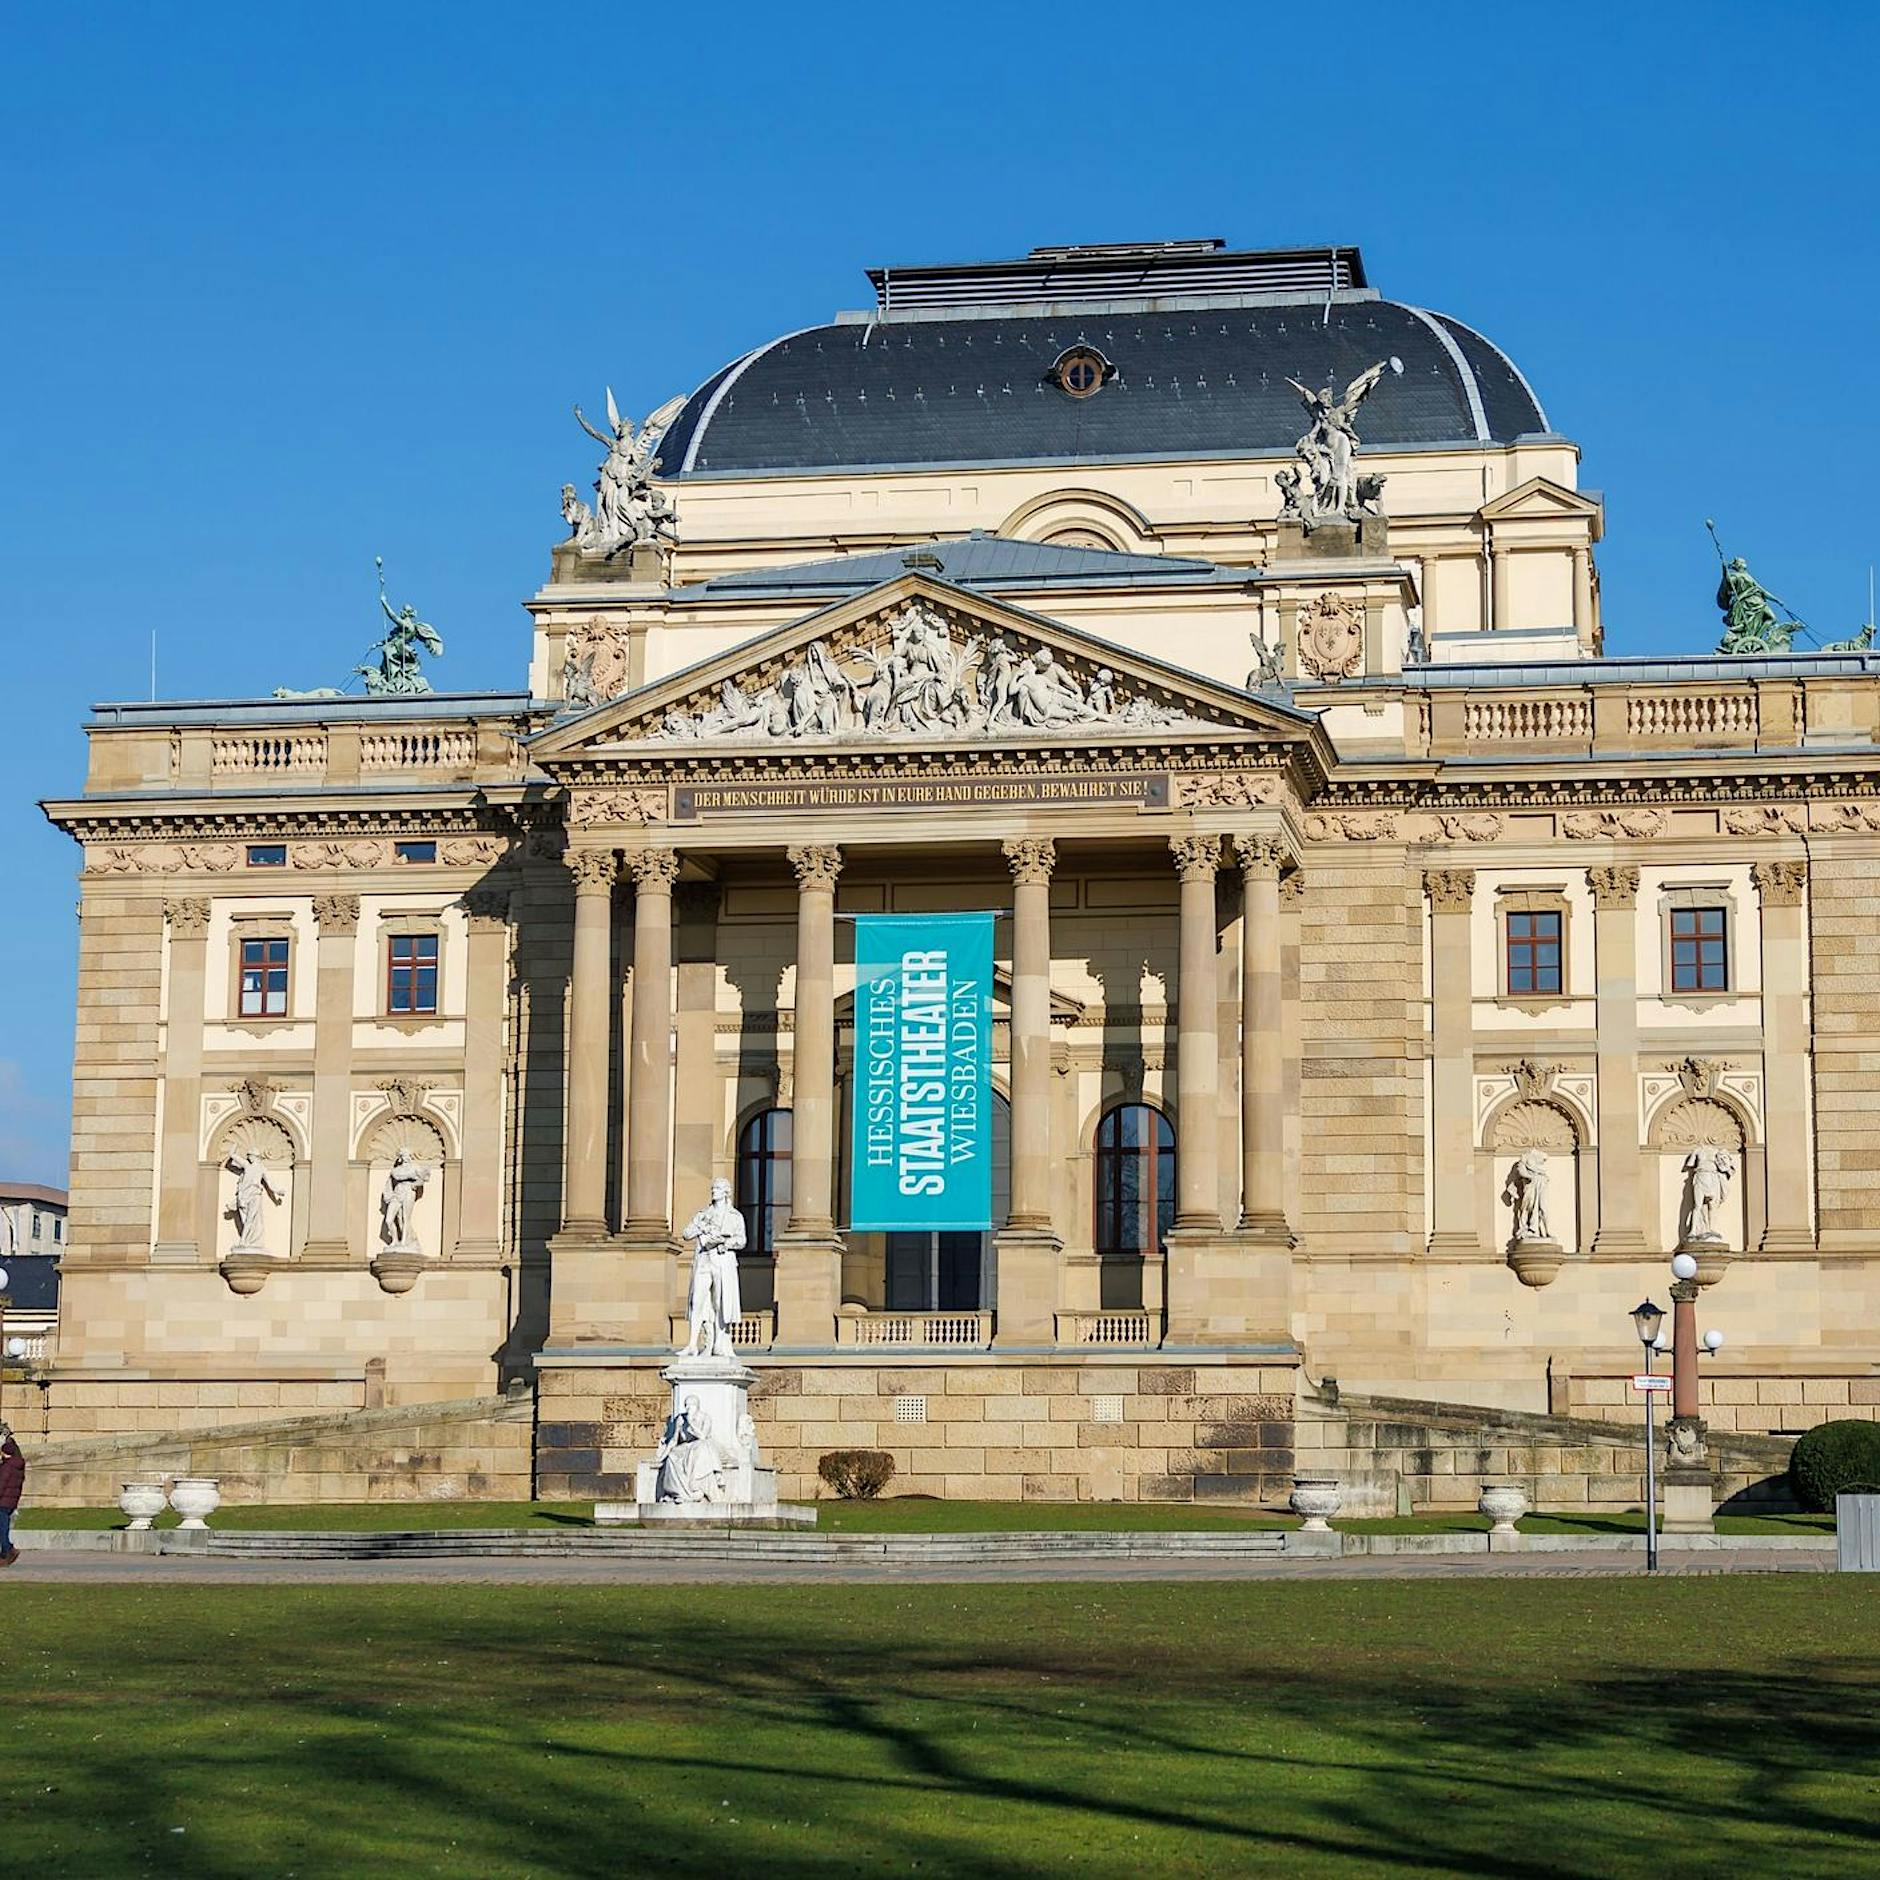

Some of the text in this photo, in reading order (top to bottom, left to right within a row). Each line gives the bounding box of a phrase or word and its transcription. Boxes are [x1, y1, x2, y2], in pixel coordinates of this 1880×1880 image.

[694, 791, 721, 808] DER
[722, 789, 806, 807] MENSCHHEIT
[809, 786, 854, 805] WÜRDE
[858, 787, 880, 803] IST
[882, 787, 896, 803] IN
[897, 786, 934, 802] EURE
[936, 785, 971, 801] HAND
[1042, 781, 1116, 799] BEWAHRET
[1119, 780, 1148, 796] SIE!
[868, 978, 896, 1167] HESSISCHES
[899, 950, 948, 1196] STAATSTHEATER
[950, 979, 979, 1166] WIESBADEN
